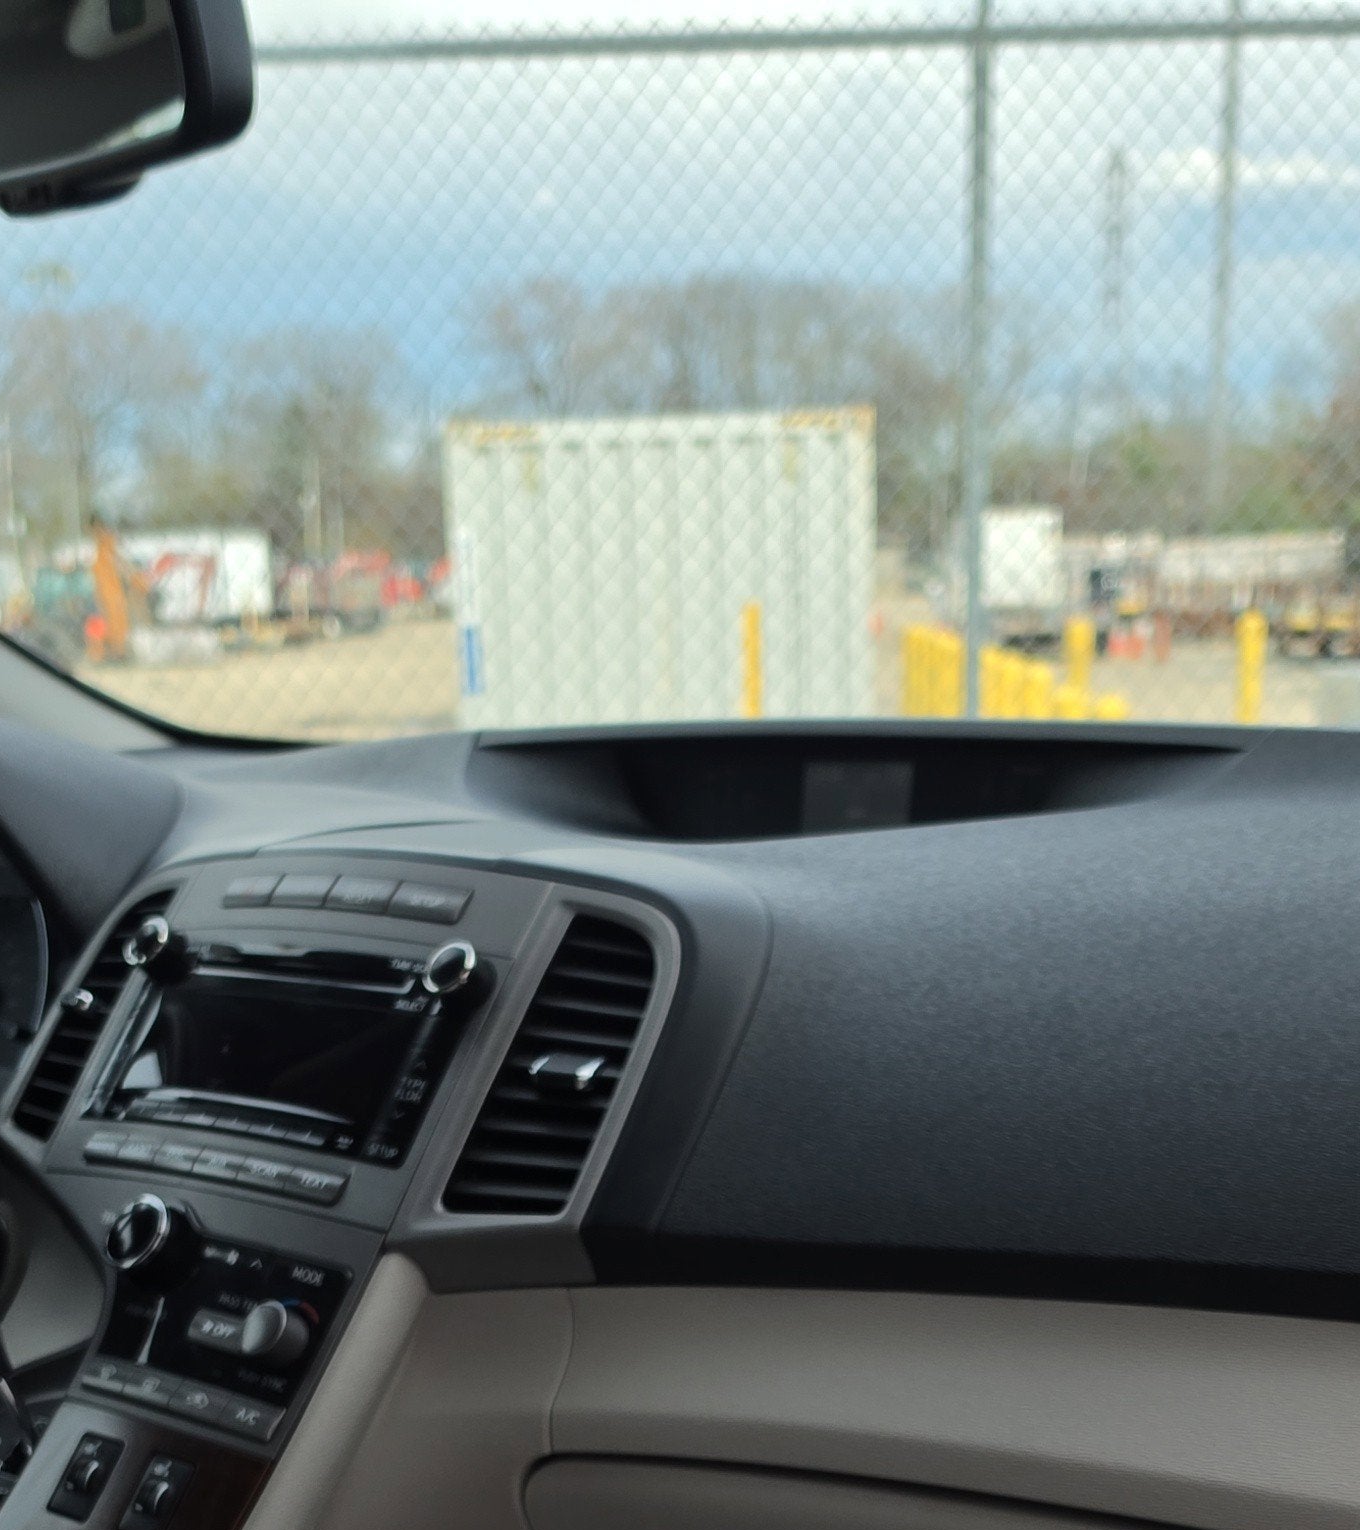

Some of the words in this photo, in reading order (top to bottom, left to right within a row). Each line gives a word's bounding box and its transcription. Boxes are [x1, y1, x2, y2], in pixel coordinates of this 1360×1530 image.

[292, 1264, 324, 1286] MODE
[212, 1324, 236, 1339] OFF
[235, 1408, 260, 1425] A/C
